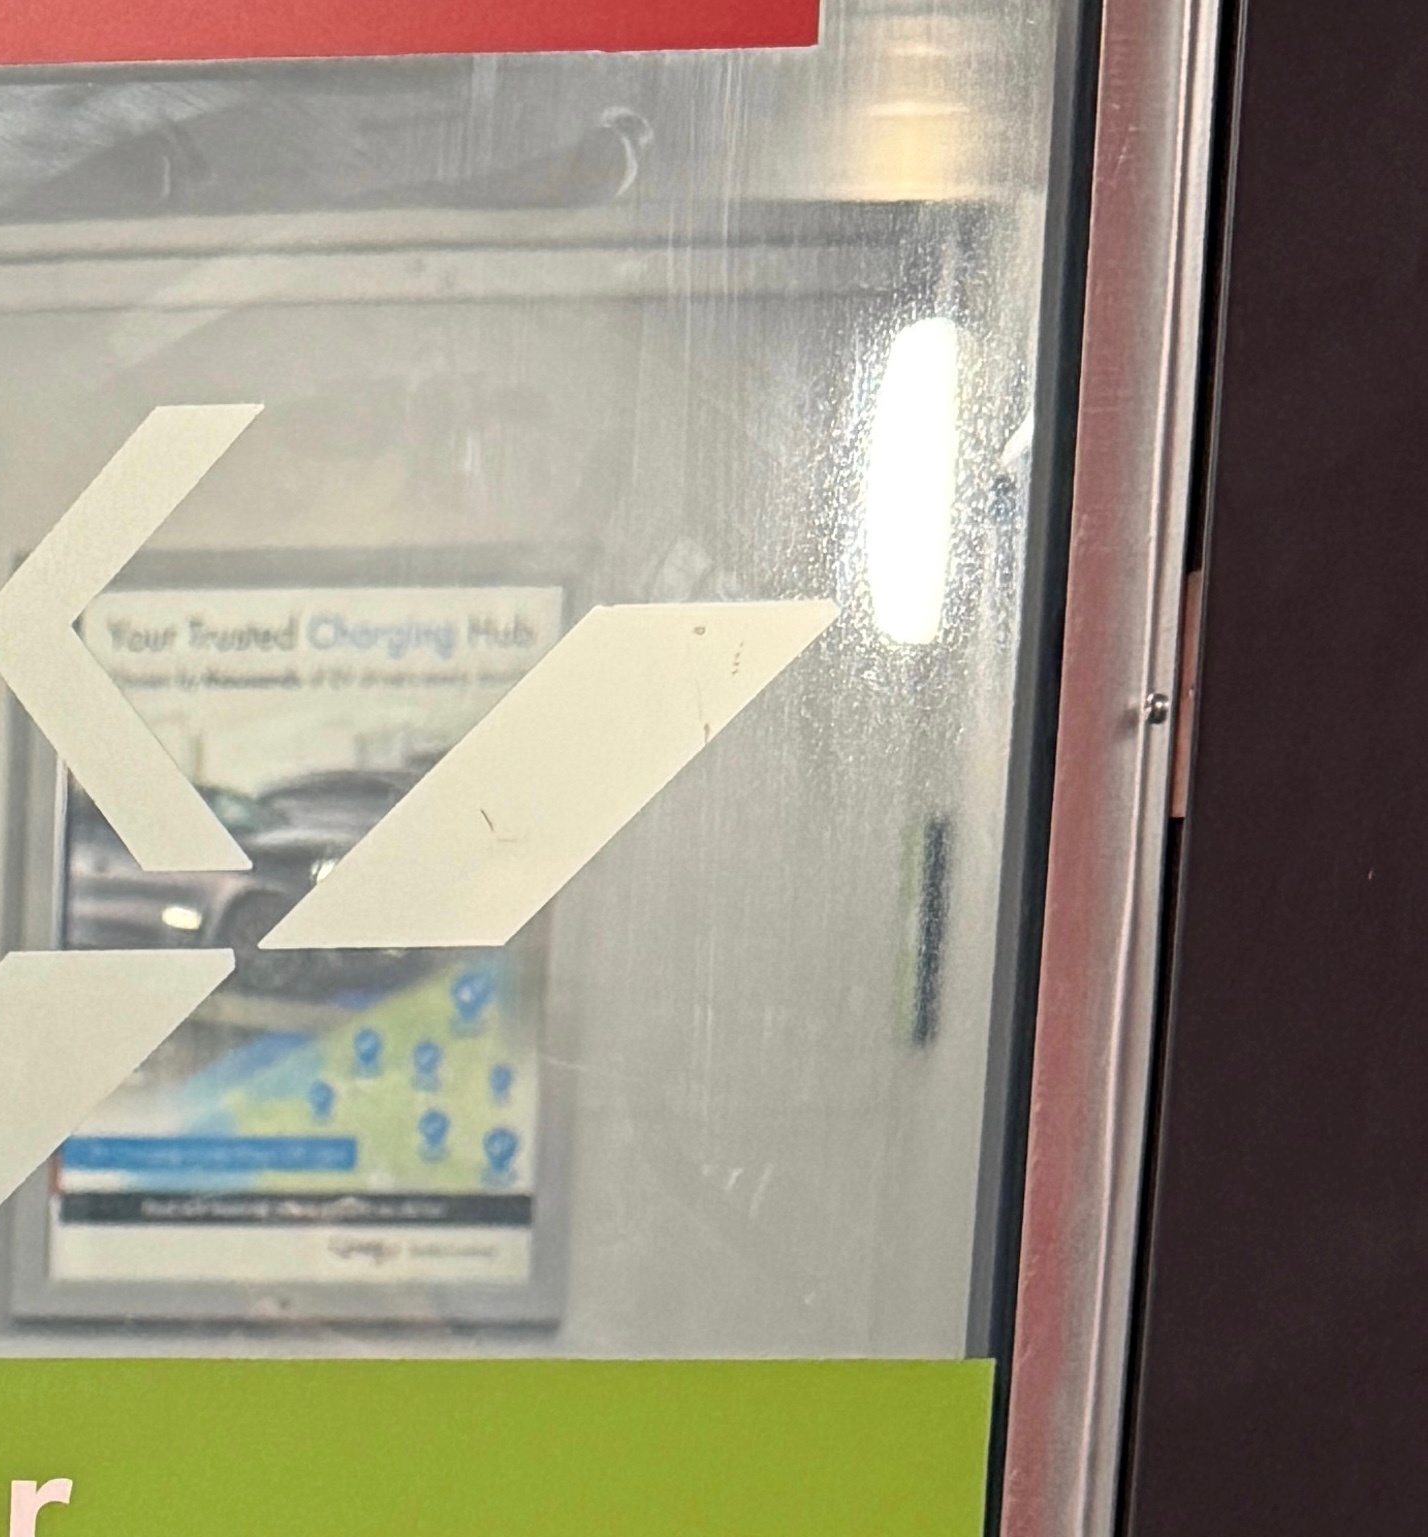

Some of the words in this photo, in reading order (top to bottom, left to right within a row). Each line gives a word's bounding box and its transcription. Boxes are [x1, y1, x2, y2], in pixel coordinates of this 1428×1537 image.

[107, 617, 178, 653] Your
[187, 613, 302, 651] Trusted
[306, 614, 459, 661] Charging
[466, 613, 535, 648] Hub
